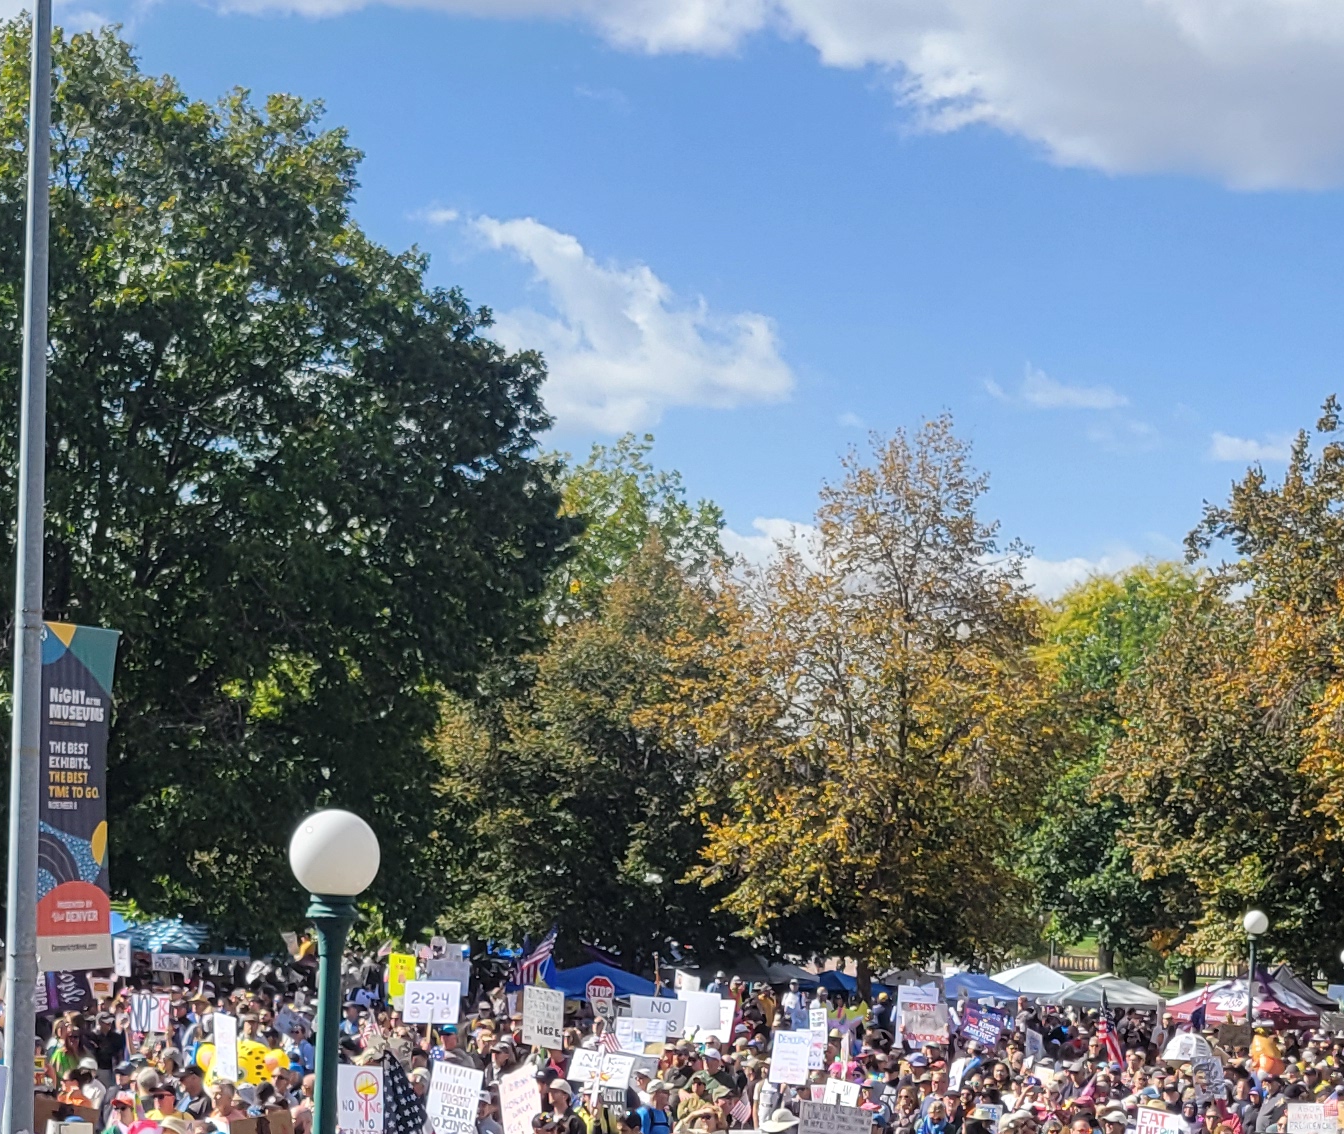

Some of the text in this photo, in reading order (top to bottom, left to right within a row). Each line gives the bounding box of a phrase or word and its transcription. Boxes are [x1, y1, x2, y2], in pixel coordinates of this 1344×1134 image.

[49, 704, 105, 722] MUSEUMS
[48, 741, 89, 755] THE BEST
[48, 756, 91, 770] EXHIBITS.
[48, 771, 89, 784] THE BEST
[48, 785, 70, 798] TIME
[72, 787, 84, 798] TO
[587, 985, 613, 998] STOP
[130, 993, 170, 1032] NOPE
[650, 1001, 672, 1014] NO
[342, 1100, 354, 1112] NO
[441, 1116, 474, 1133] KINGS
[1140, 1111, 1171, 1128] EAT
